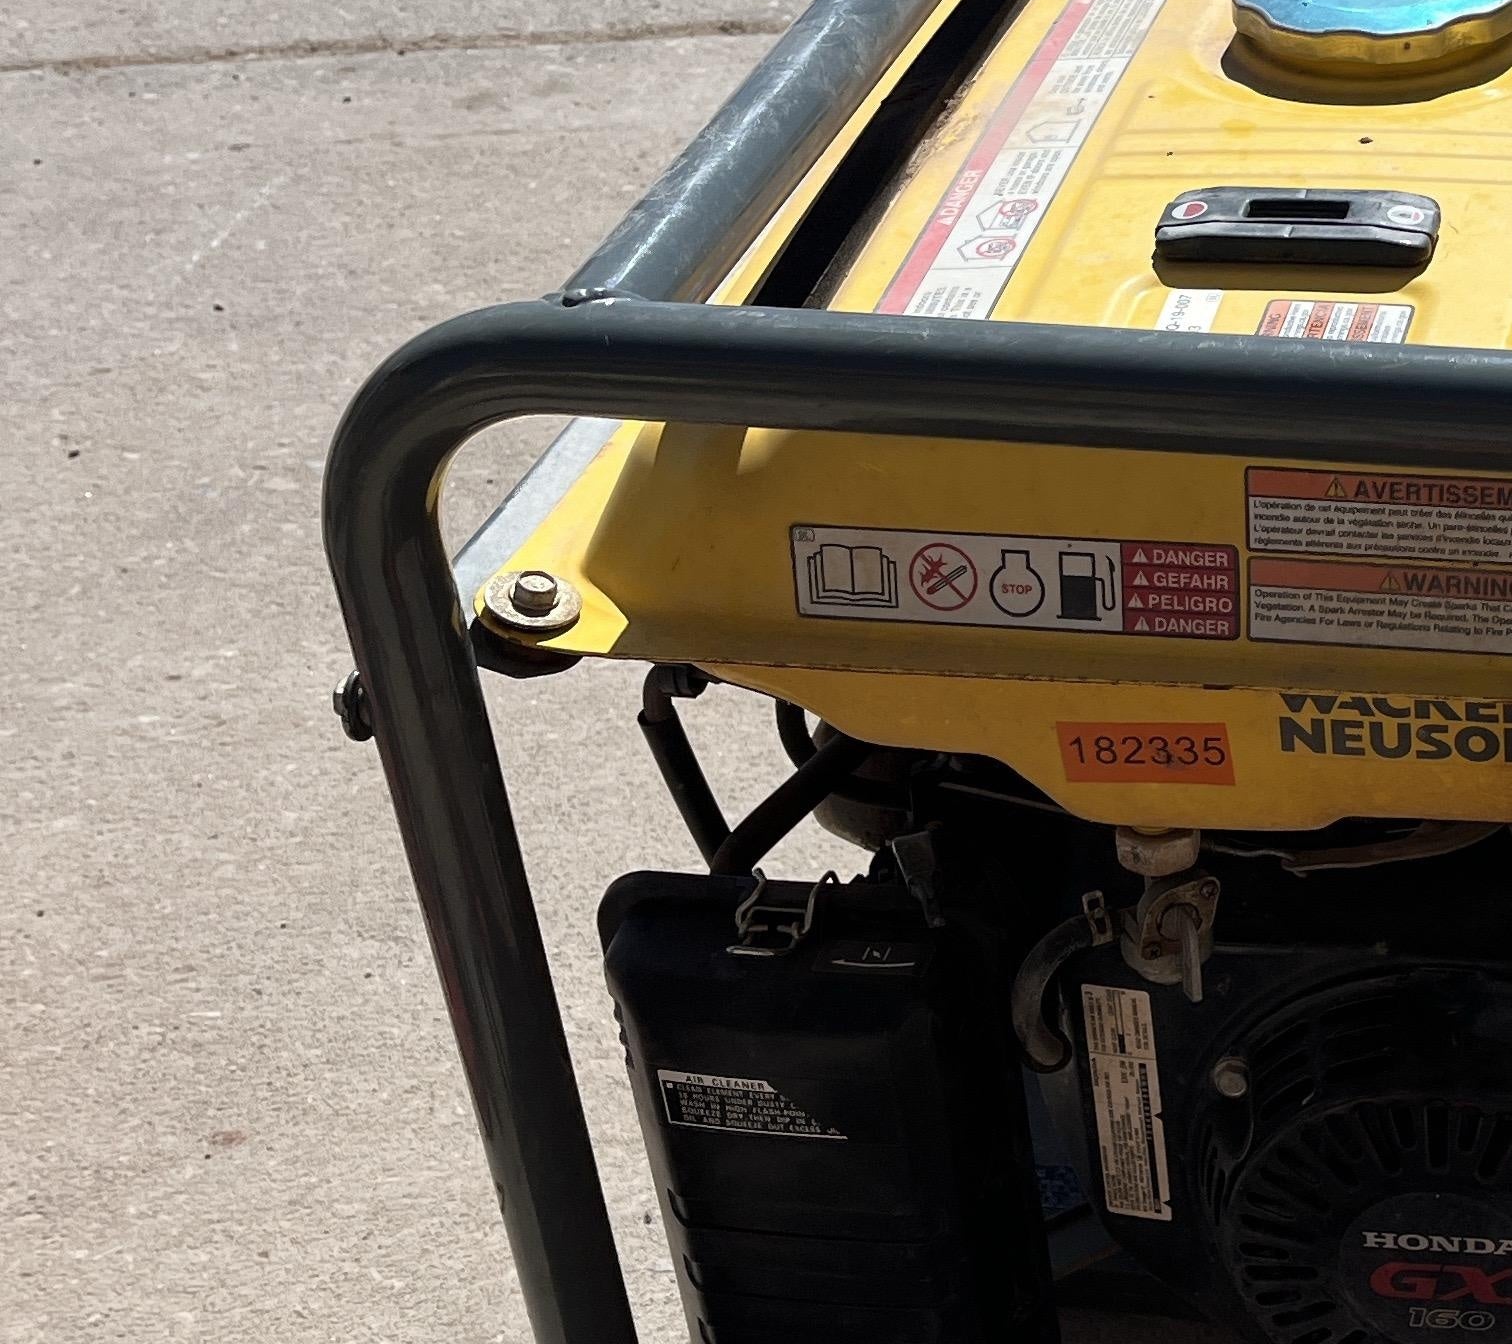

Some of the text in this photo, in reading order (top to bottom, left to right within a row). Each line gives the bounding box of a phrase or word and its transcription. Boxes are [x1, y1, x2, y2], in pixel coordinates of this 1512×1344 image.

[942, 169, 983, 219] DANGER
[1152, 549, 1229, 568] DANGER
[1001, 583, 1032, 595] STOP
[1154, 571, 1229, 591] GEFAHR
[1148, 593, 1233, 613] PELIGRO
[1303, 592, 1313, 600] of
[1315, 593, 1333, 602] This
[1337, 594, 1386, 606] Equipment
[1389, 597, 1408, 607] May
[1319, 617, 1335, 626] For
[1388, 609, 1407, 620] May
[1472, 614, 1489, 623] The
[1155, 618, 1230, 636] DANGER
[1069, 735, 1226, 765] 182335
[685, 1075, 765, 1090] AIR CLEANER
[1409, 1307, 1496, 1332] 160
